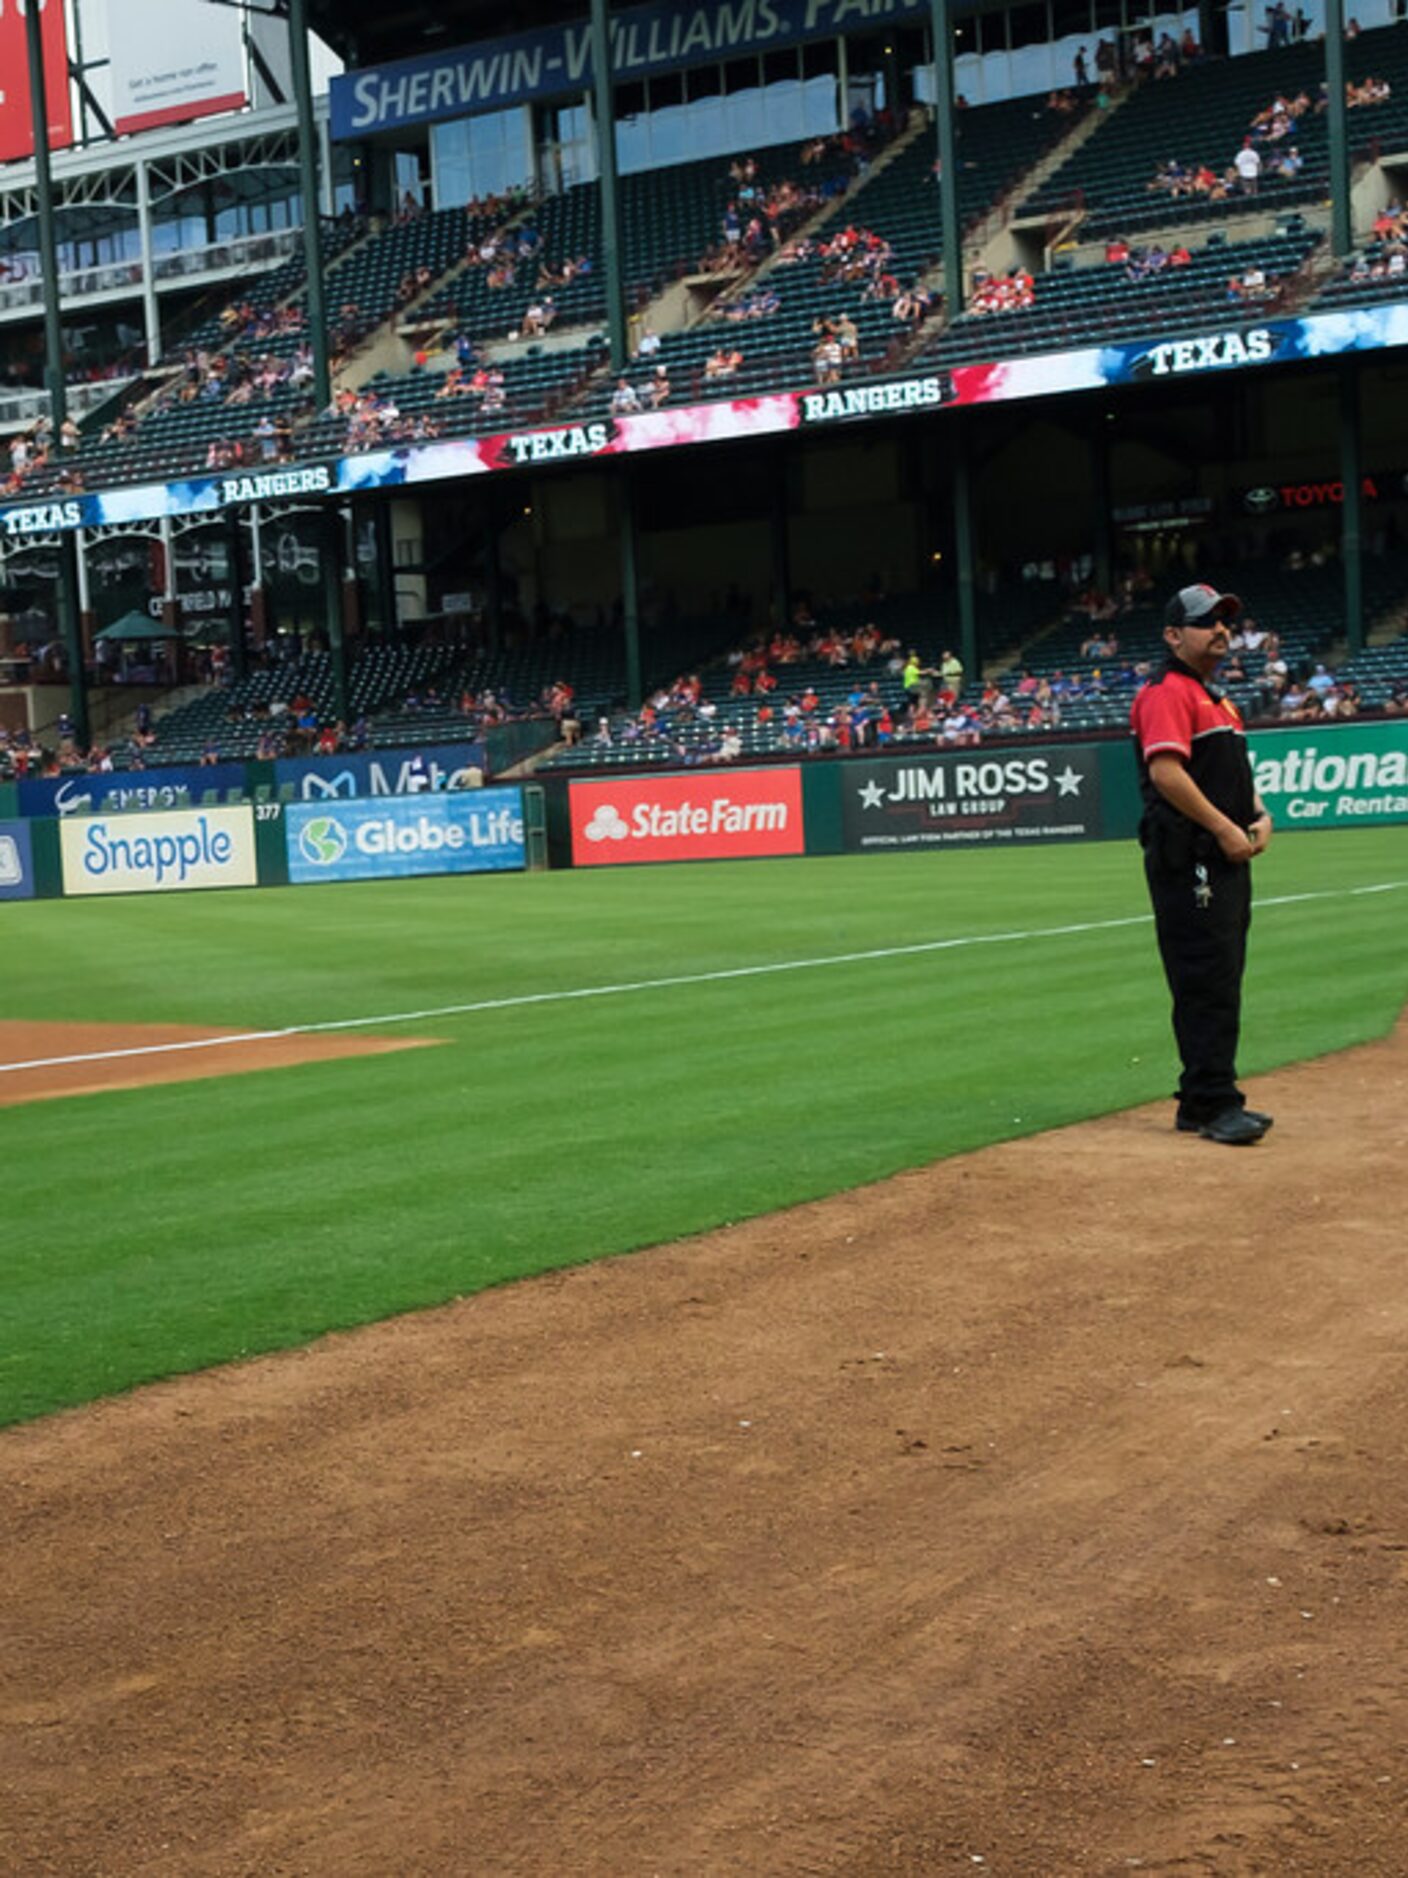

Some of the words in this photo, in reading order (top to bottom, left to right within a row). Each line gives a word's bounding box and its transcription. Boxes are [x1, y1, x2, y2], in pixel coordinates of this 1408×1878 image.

[5, 502, 81, 535] TEXAS
[223, 467, 329, 502] RANGERS
[511, 425, 608, 463] TEXAS
[804, 379, 941, 421] RANGERS
[1148, 330, 1271, 375] TEXAS
[1280, 479, 1377, 506] TOYOA
[887, 767, 945, 801] JIM
[956, 759, 1049, 797] ROSS
[256, 805, 280, 821] 377
[930, 803, 958, 817] LAW
[961, 800, 1005, 815] GROUP
[1287, 798, 1329, 819] Car
[84, 815, 231, 883] Snapple
[355, 817, 464, 855] Globe
[470, 809, 525, 846] Life
